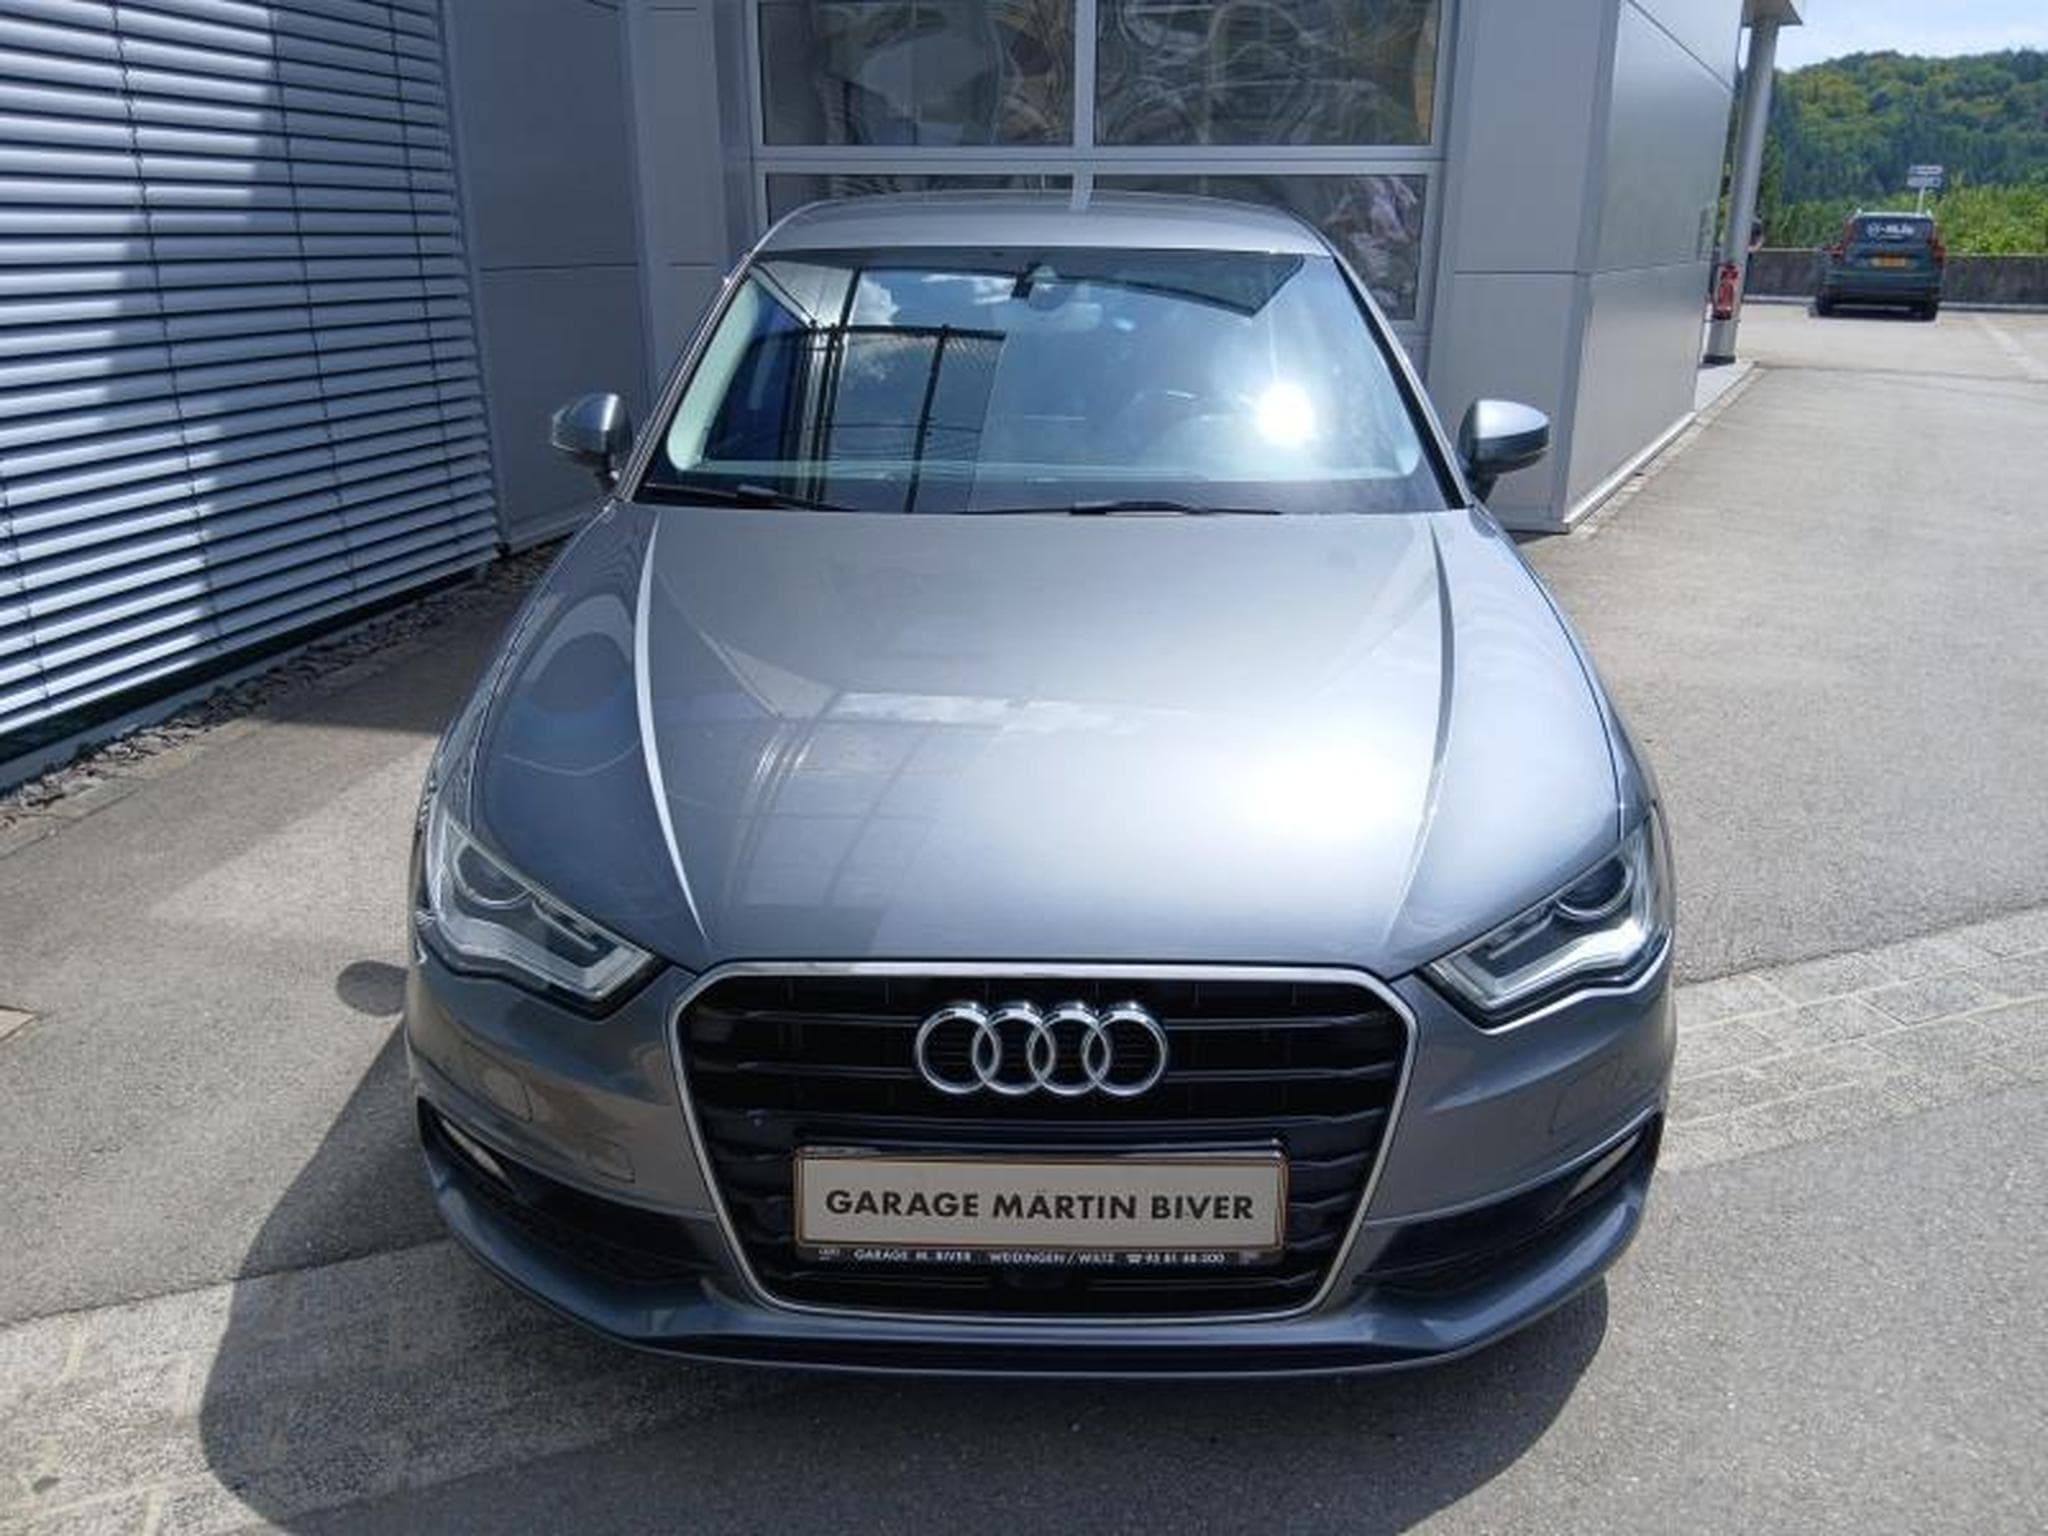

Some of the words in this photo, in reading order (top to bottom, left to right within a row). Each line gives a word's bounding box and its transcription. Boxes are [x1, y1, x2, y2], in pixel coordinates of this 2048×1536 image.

[826, 1190, 979, 1218] GARAGE
[992, 1194, 1137, 1219] MARTIN
[1151, 1196, 1254, 1220] BIVER
